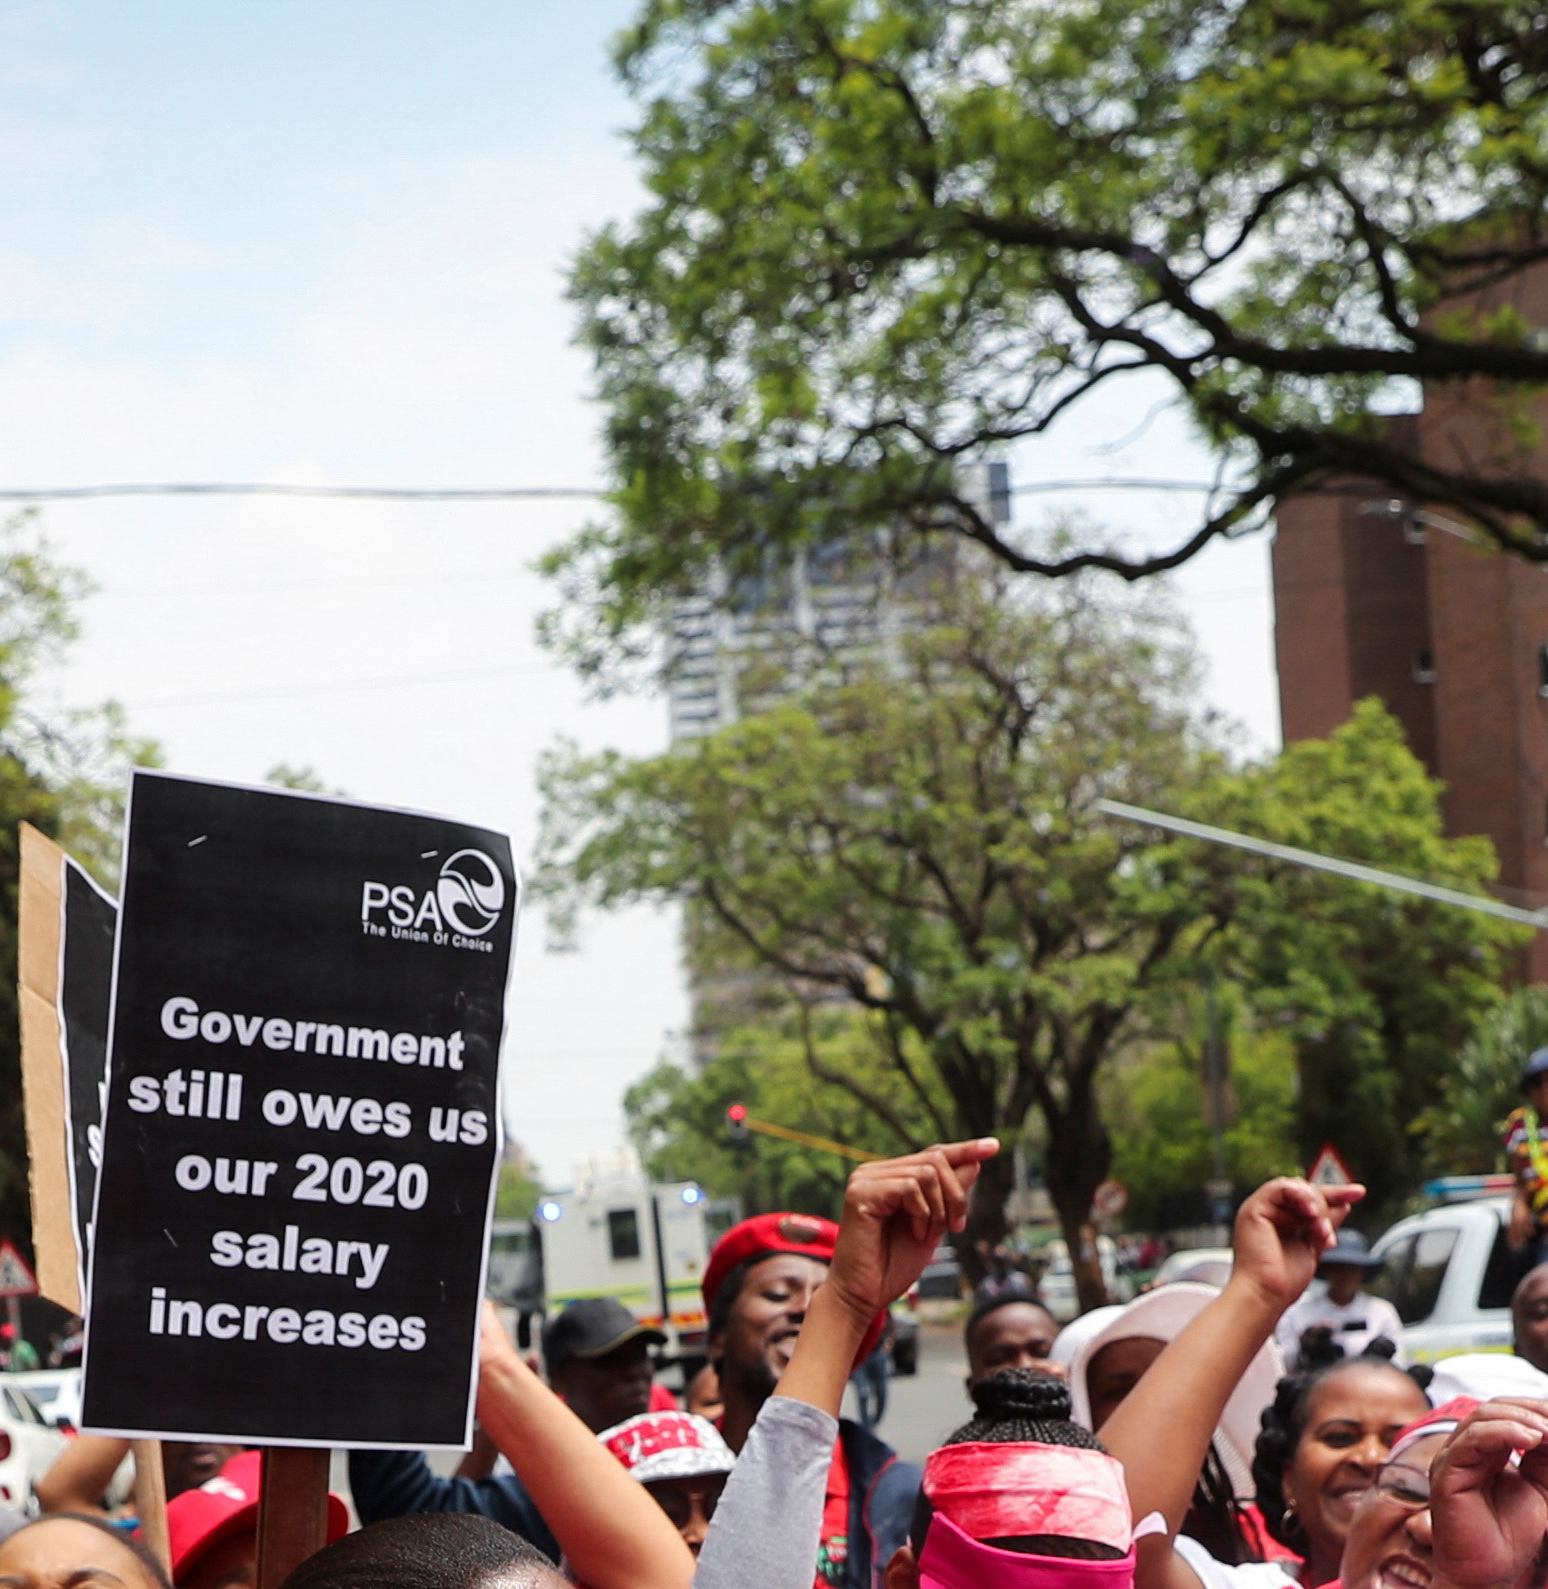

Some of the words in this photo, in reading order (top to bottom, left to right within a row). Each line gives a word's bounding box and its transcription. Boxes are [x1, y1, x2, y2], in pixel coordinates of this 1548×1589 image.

[361, 881, 443, 931] PSA
[362, 921, 387, 938] The
[391, 926, 429, 943] Union
[433, 932, 449, 946] Of
[451, 934, 494, 953] Choice
[160, 997, 464, 1070] Government
[128, 1069, 243, 1121] still
[262, 1088, 412, 1138] owes
[428, 1105, 489, 1145] us
[175, 1155, 278, 1196] our
[292, 1154, 430, 1210] 2020
[210, 1225, 390, 1288] salary
[149, 1288, 428, 1352] increases
